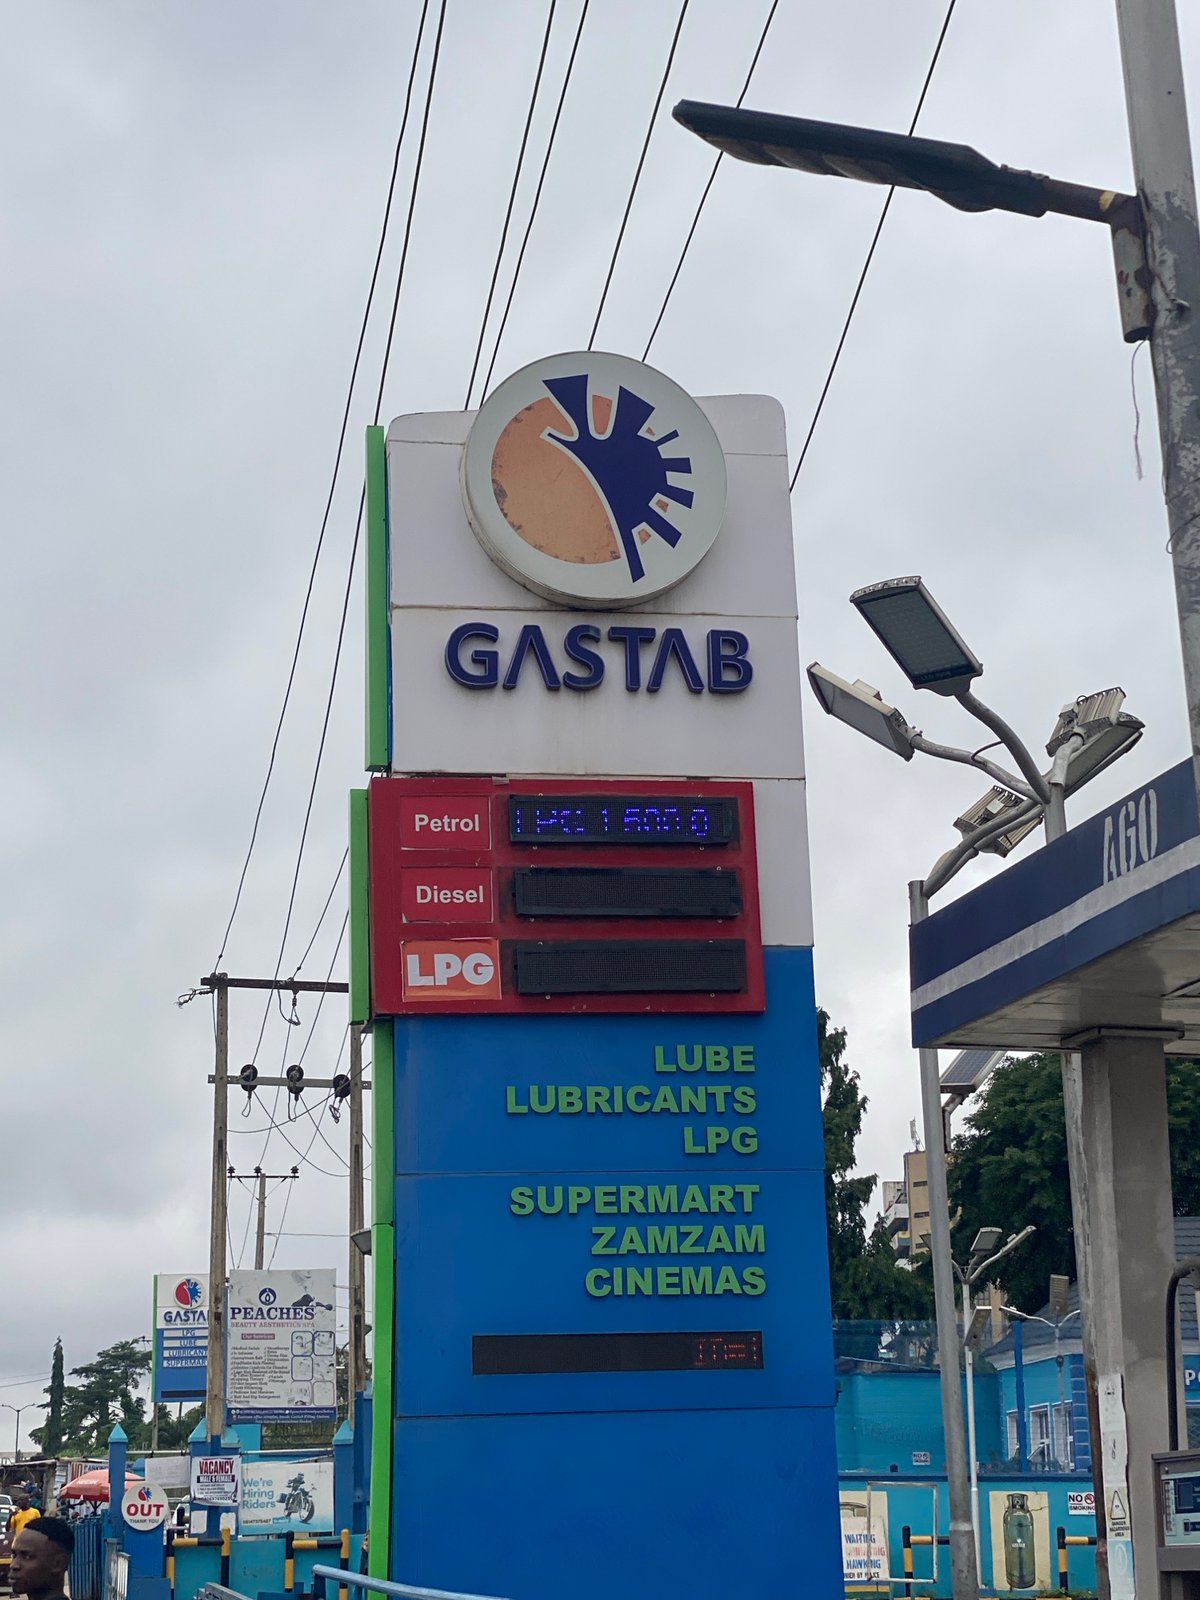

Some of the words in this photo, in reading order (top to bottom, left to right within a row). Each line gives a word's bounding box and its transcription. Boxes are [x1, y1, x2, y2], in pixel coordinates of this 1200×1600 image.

[445, 622, 753, 693] GASTAB
[414, 813, 480, 832] Petrol
[1103, 788, 1158, 884] AGO
[416, 885, 484, 904] Diesel
[406, 952, 494, 987] LPG
[655, 1044, 756, 1073] LUBE
[506, 1085, 757, 1114] LUBRICANTS
[683, 1126, 758, 1154] LPG
[509, 1184, 760, 1216] SUPERMART
[591, 1225, 766, 1255] ZAMZAM
[585, 1266, 767, 1297] CINEMAS
[163, 1310, 209, 1323] GASTA
[230, 1306, 315, 1321] PEACHES
[182, 1329, 196, 1337] LPG
[180, 1339, 197, 1348] LUBE
[199, 1460, 234, 1475] VACANCY
[242, 1478, 273, 1488] We're
[242, 1489, 274, 1500] Hiring
[1068, 1494, 1083, 1503] NO
[126, 1503, 164, 1517] OUT
[242, 1500, 276, 1509] Riders
